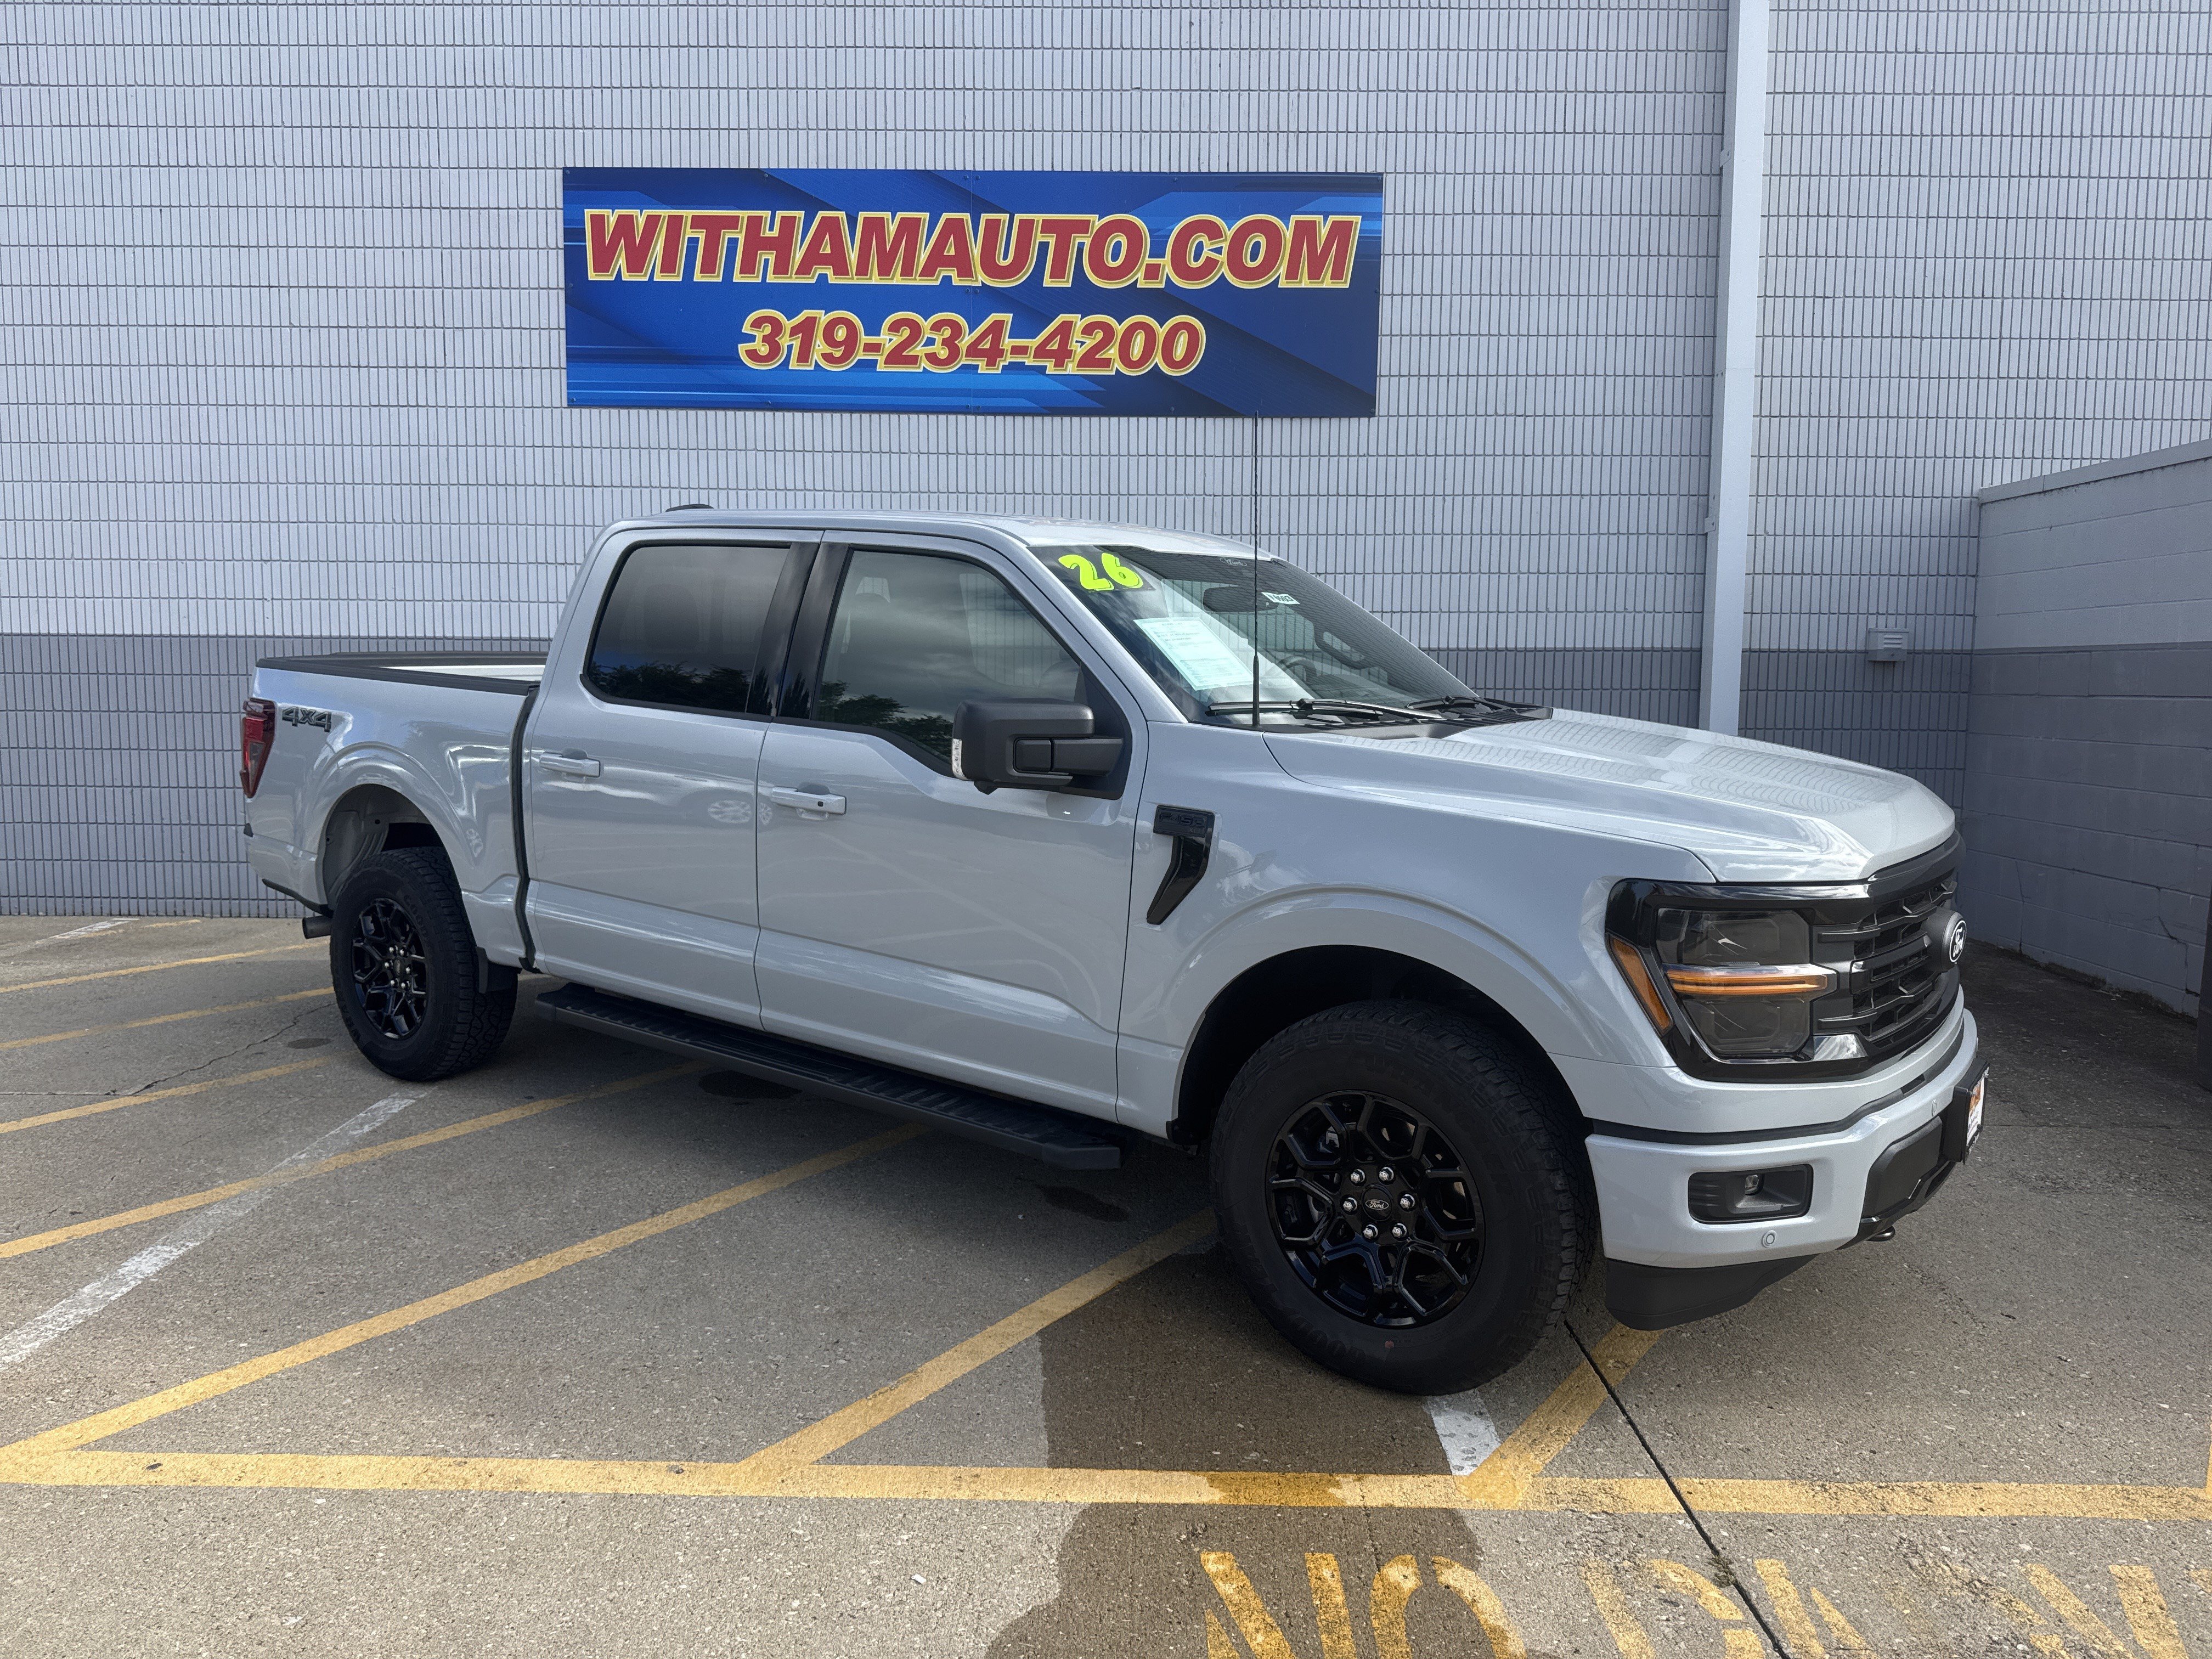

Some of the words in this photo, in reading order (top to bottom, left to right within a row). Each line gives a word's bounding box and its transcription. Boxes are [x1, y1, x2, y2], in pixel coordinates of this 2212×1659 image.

[585, 210, 1362, 289] WITHAMAUTO.COM
[738, 309, 1206, 376] 319-234-4200
[1058, 552, 1143, 591] 26
[1369, 1200, 1385, 1209] Ford
